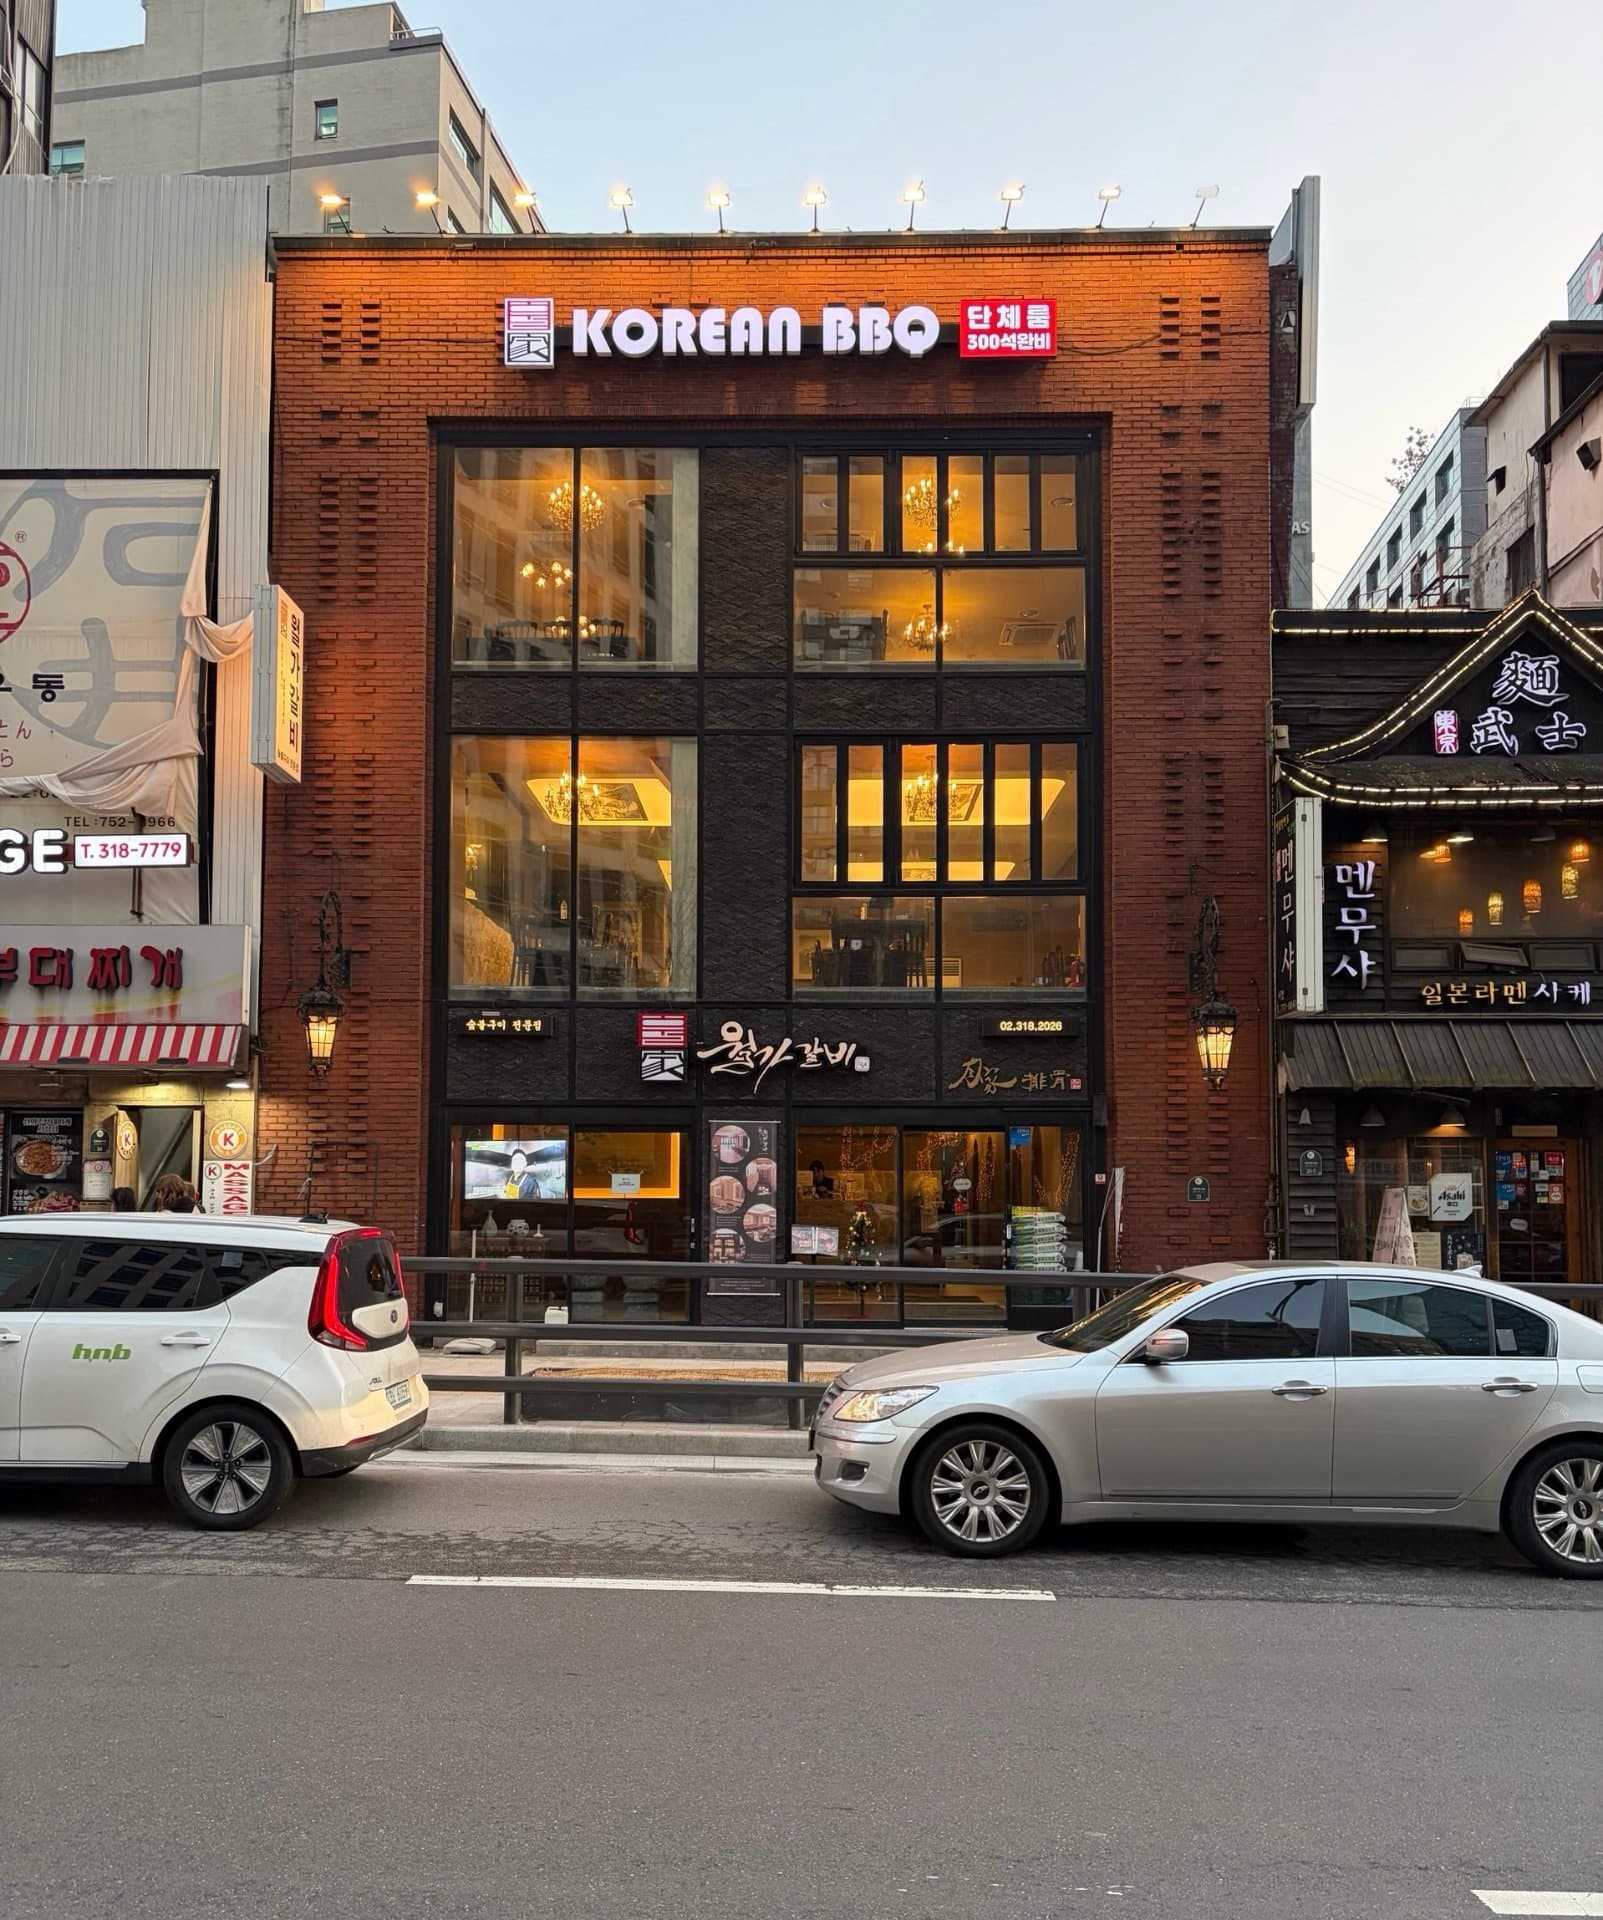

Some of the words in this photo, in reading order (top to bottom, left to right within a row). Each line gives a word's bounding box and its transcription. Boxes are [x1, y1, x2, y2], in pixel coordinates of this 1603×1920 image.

[573, 307, 801, 357] KOREAN
[822, 305, 941, 358] BBQ
[99, 842, 182, 858] 318-7779
[999, 1020, 1063, 1031] 02.318.2026
[1438, 1190, 1467, 1201] Asahi
